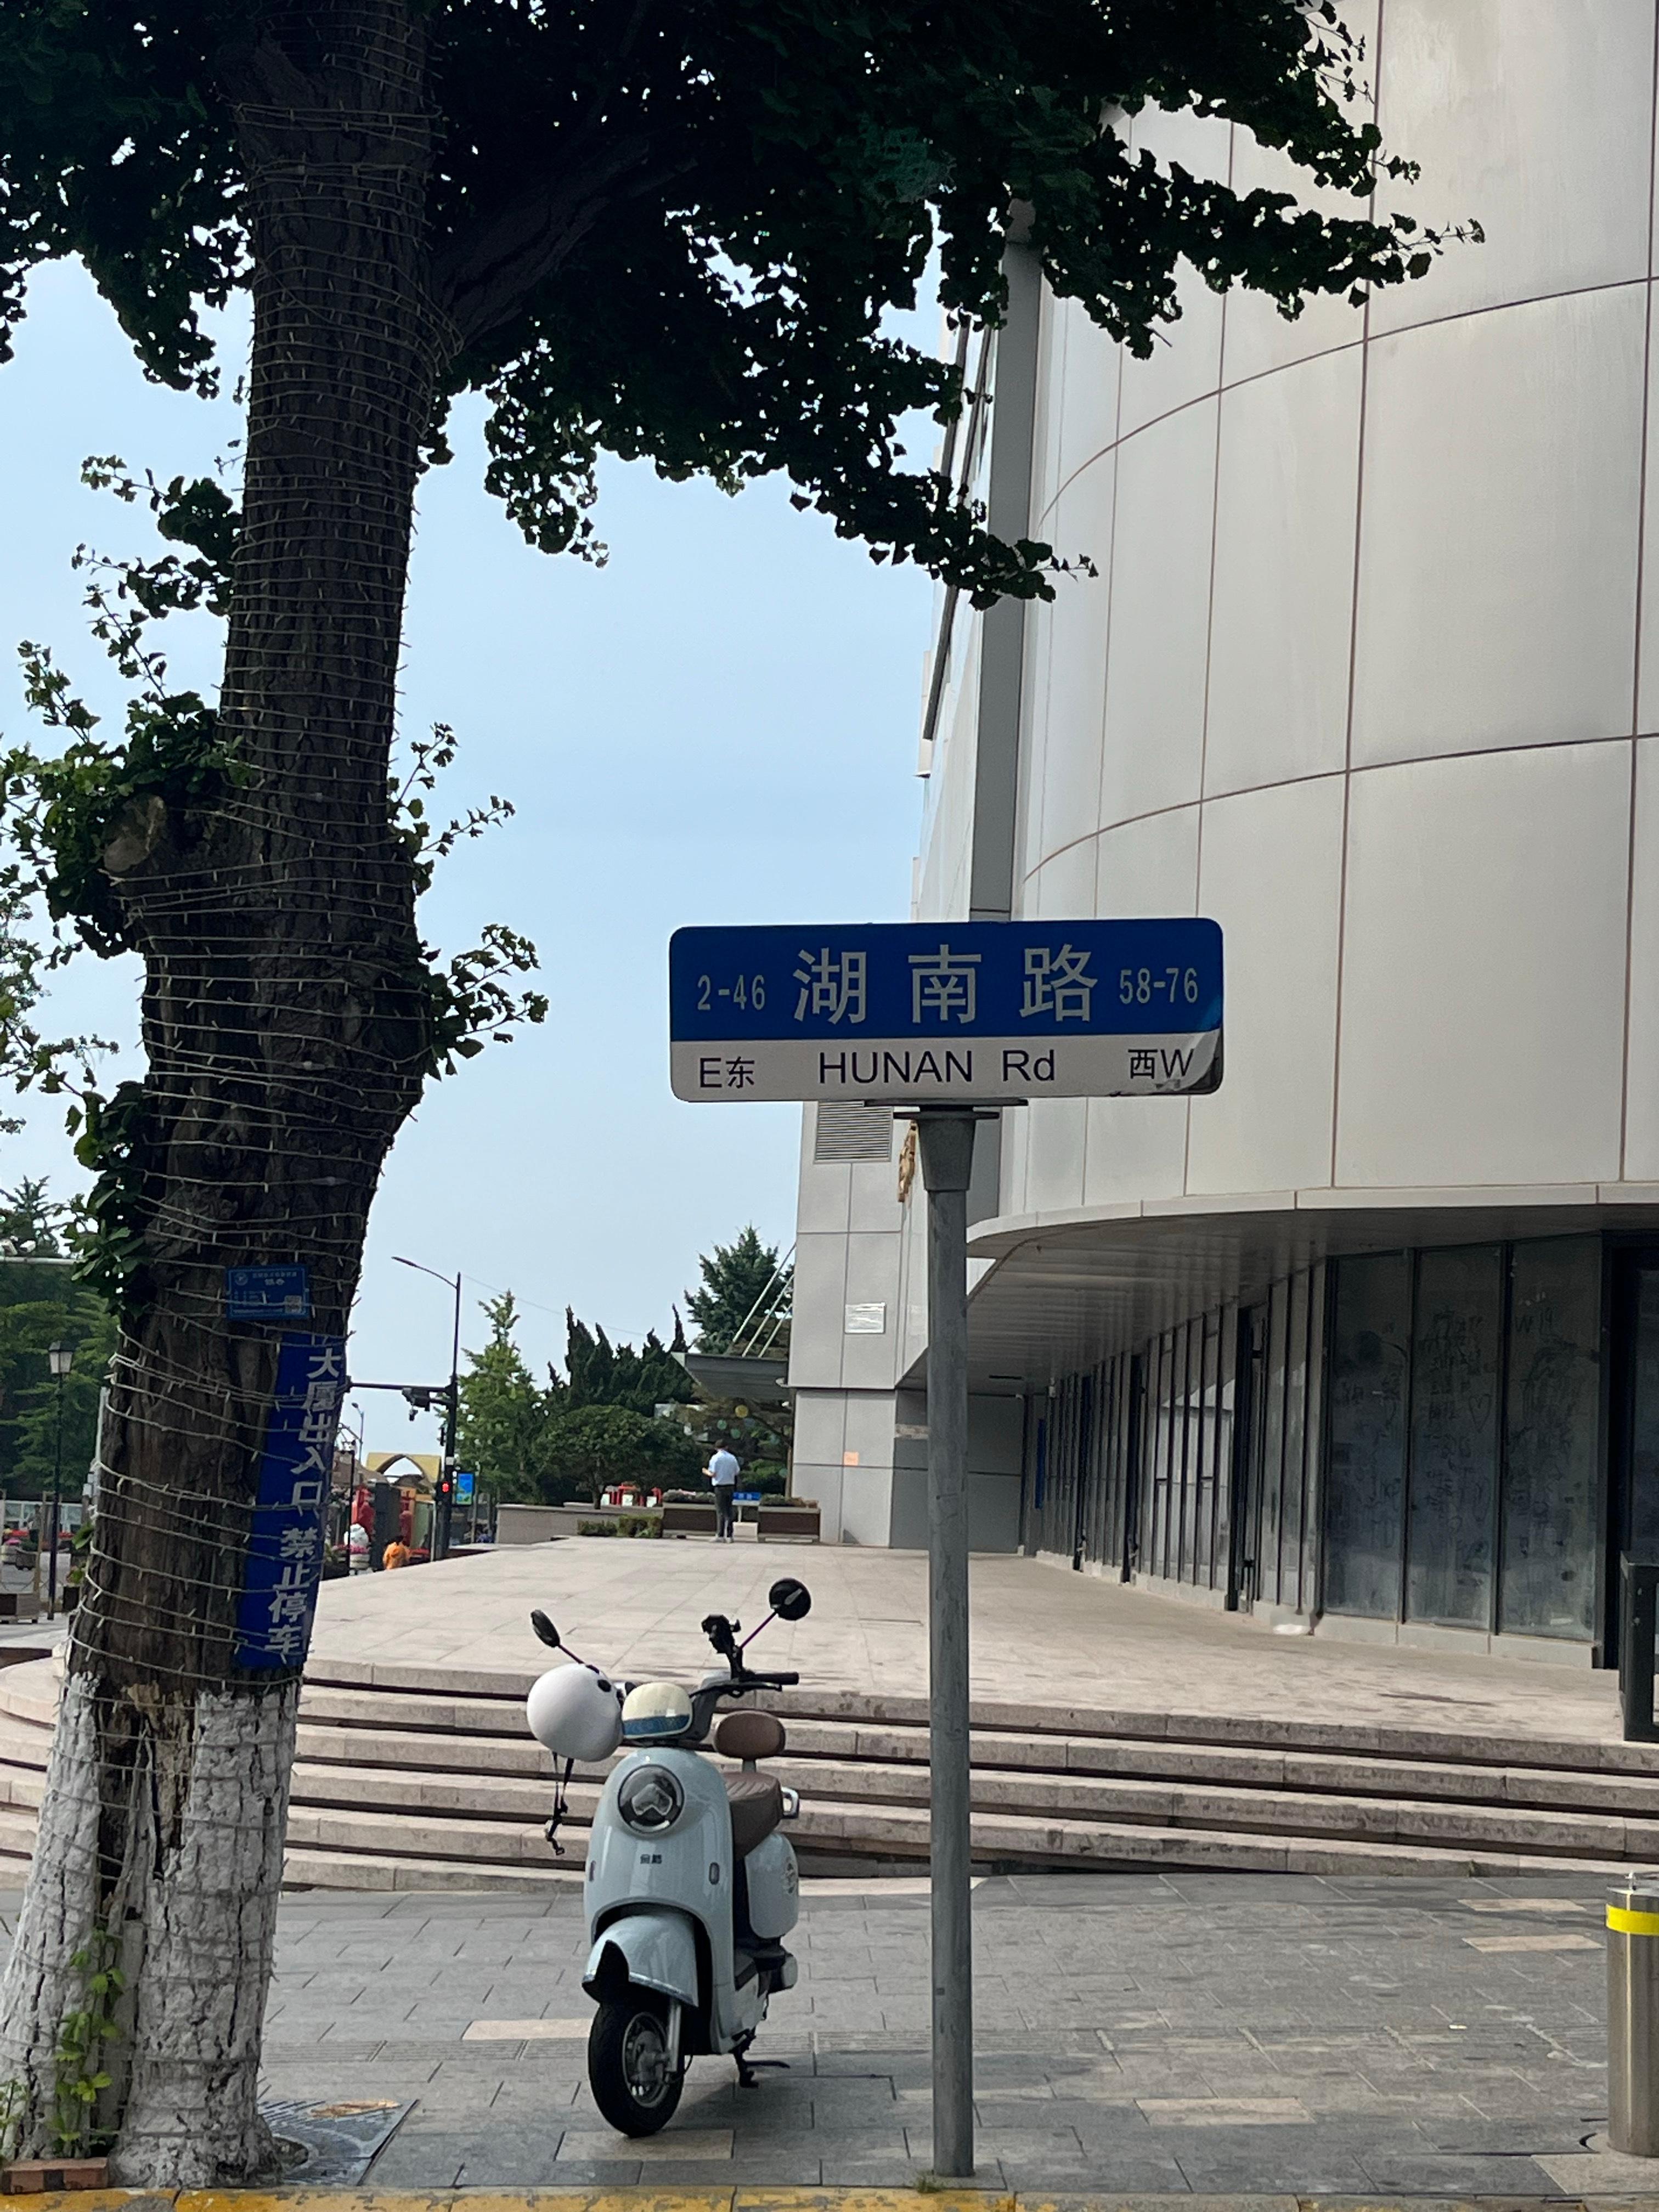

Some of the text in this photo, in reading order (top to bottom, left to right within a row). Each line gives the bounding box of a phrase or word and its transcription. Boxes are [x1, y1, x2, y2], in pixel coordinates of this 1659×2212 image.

[697, 944, 1198, 1025] 2-46 湖南路 58-76
[699, 1048, 1194, 1089] E东 HUNAN Rd 西W
[264, 1527, 318, 1655] 禁止停车
